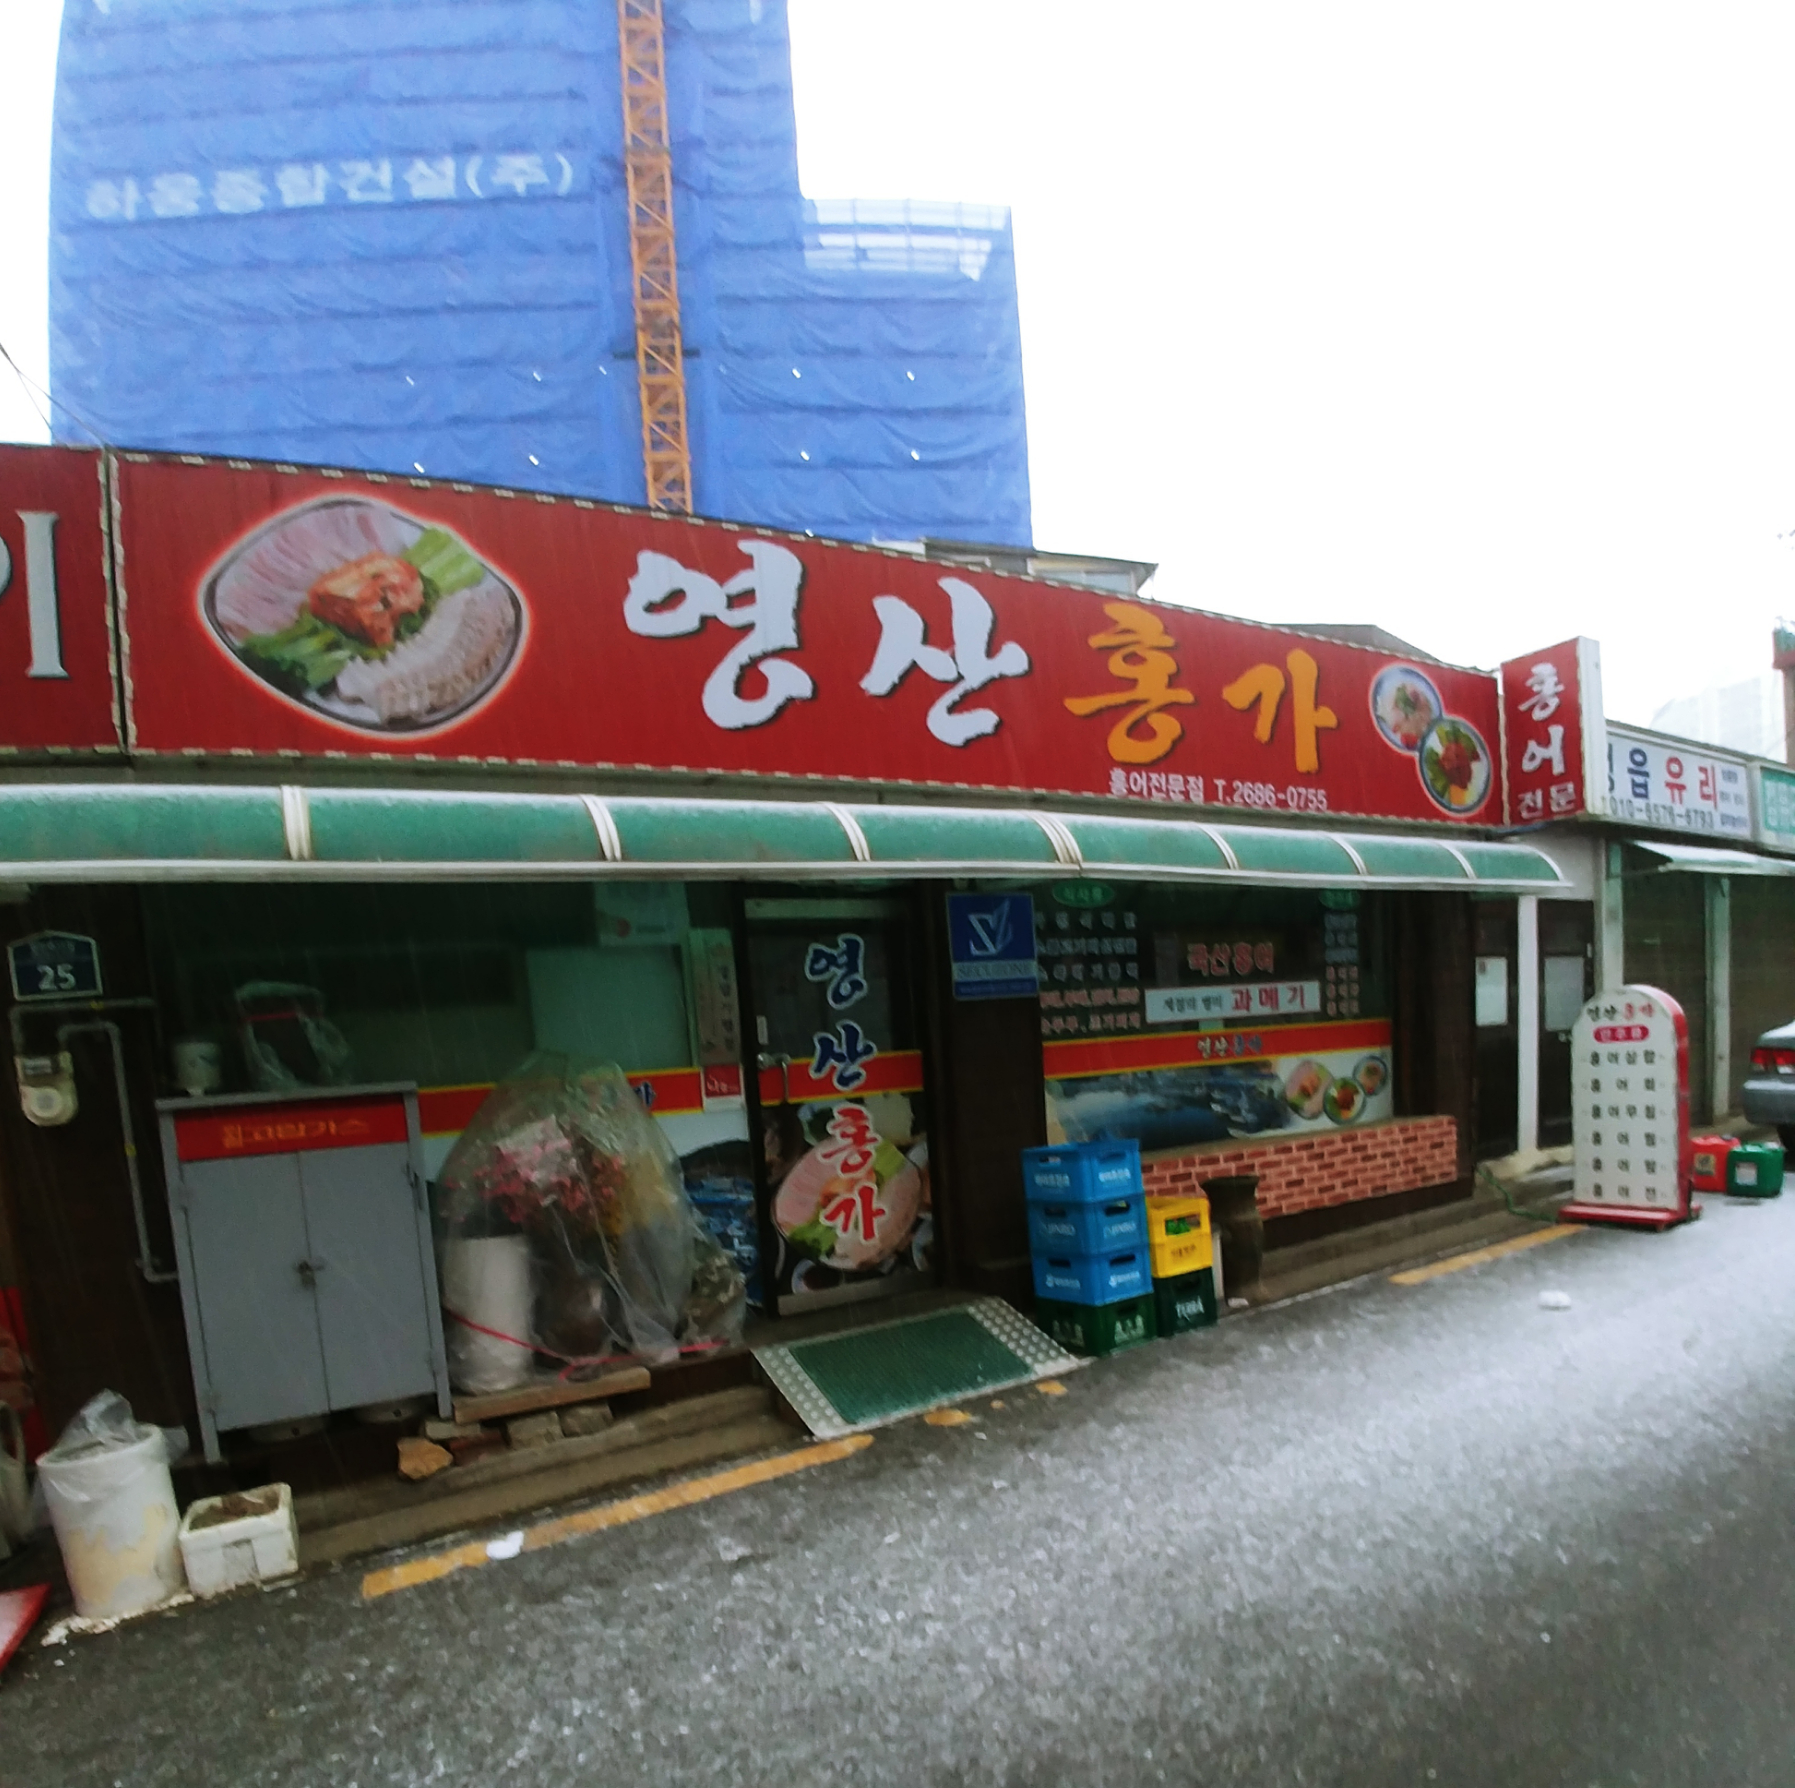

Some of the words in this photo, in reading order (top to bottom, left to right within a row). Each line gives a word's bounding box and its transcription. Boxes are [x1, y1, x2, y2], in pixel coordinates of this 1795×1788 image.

[1517, 662, 1565, 775] 홍어
[1110, 768, 1204, 804] 홍어전문점
[1517, 782, 1576, 819] 전문
[36, 963, 76, 991] 25
[1231, 985, 1305, 1013] 과메기
